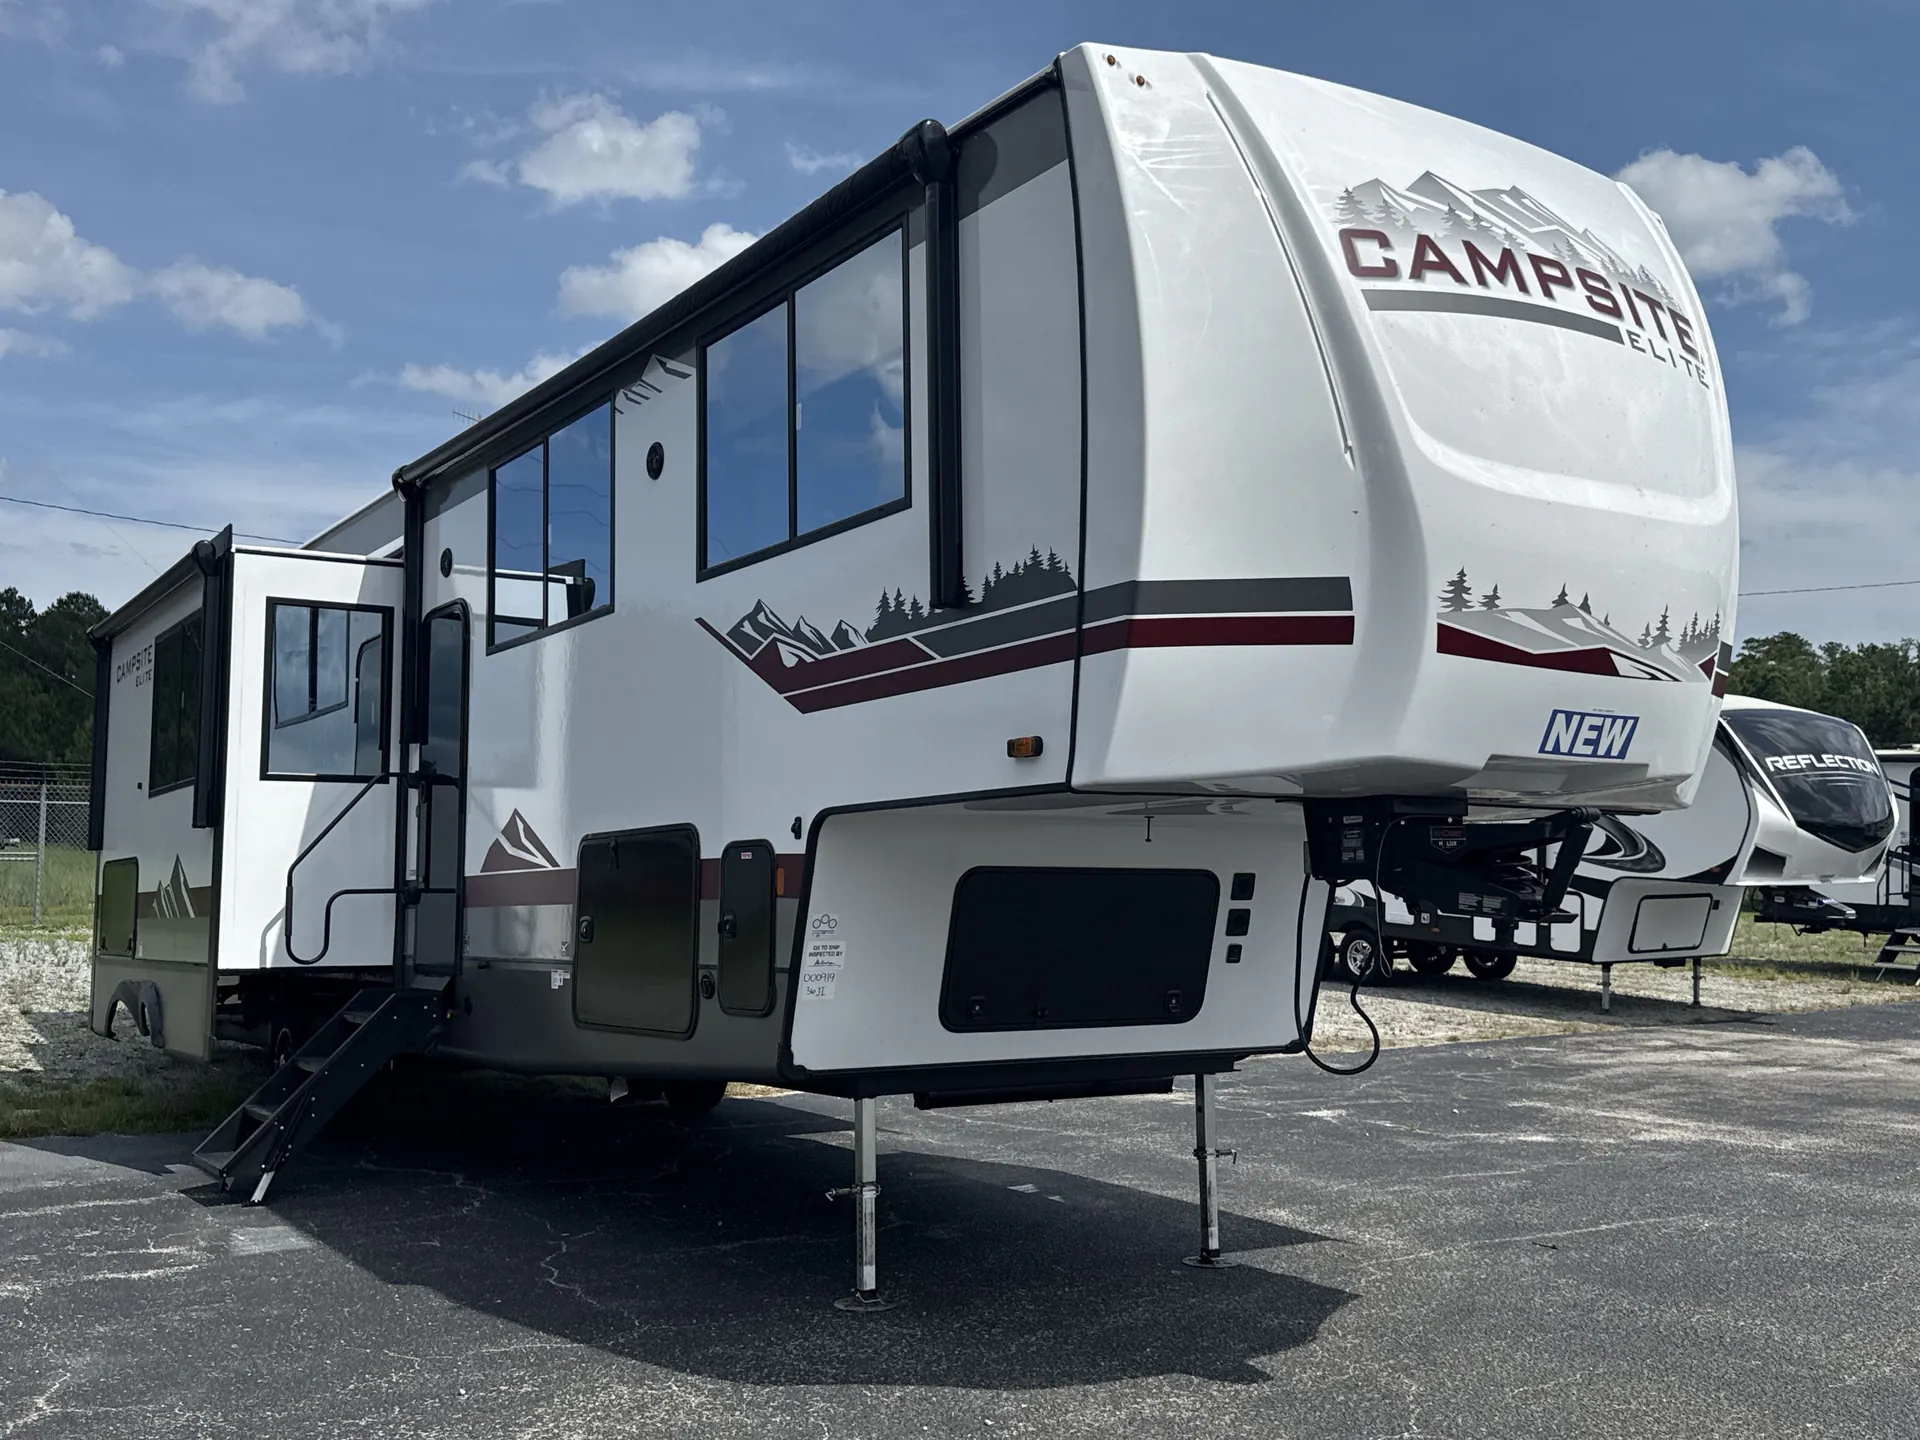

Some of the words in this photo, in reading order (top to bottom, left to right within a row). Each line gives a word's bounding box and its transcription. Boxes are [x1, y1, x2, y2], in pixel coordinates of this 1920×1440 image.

[1339, 228, 1703, 362] CAMPSITE
[1626, 328, 1710, 390] ELITE
[117, 644, 153, 684] CAMPSITE
[136, 669, 152, 688] ELITE
[1544, 712, 1635, 757] NEW
[1765, 754, 1880, 776] REFLECTION
